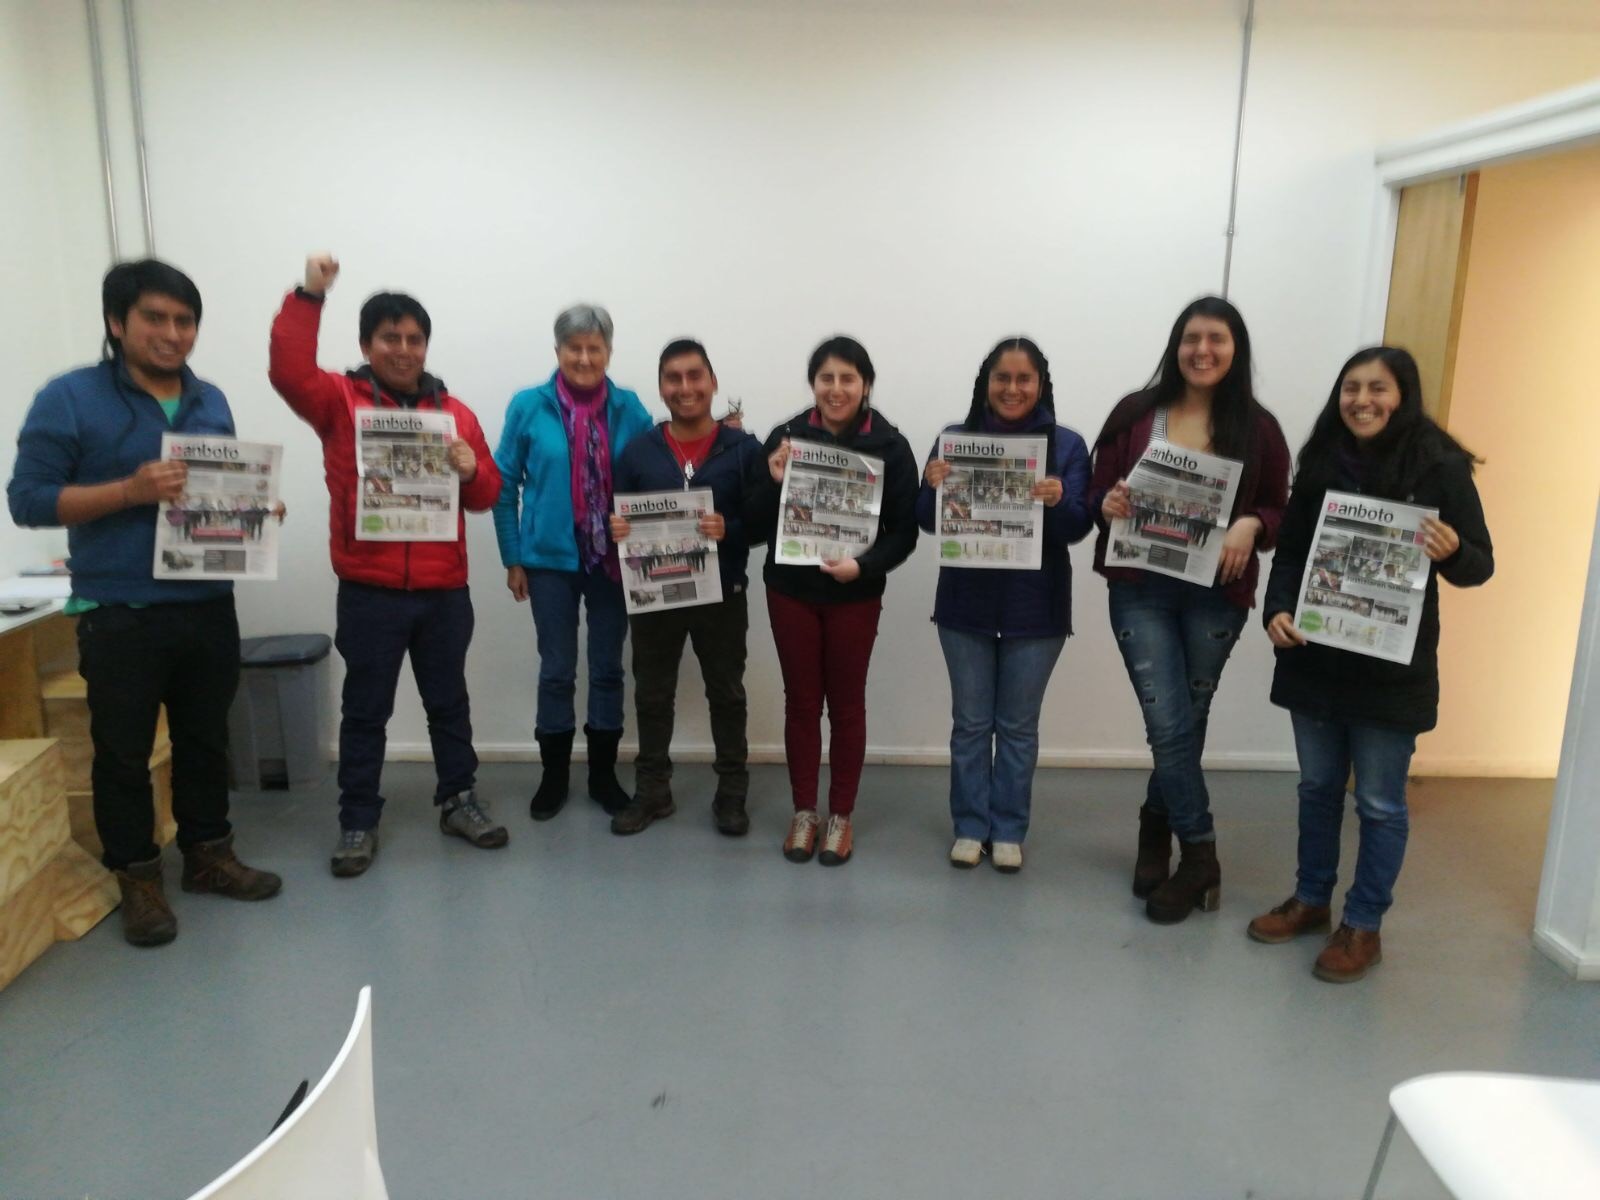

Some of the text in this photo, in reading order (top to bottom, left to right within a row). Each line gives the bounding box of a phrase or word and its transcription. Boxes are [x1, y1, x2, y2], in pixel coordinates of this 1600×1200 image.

[372, 414, 423, 430] anboto
[954, 441, 1005, 456] anboto
[803, 449, 849, 467] anboto
[1150, 448, 1198, 471] anboto
[630, 498, 678, 513] anboto
[1338, 503, 1394, 524] anboto
